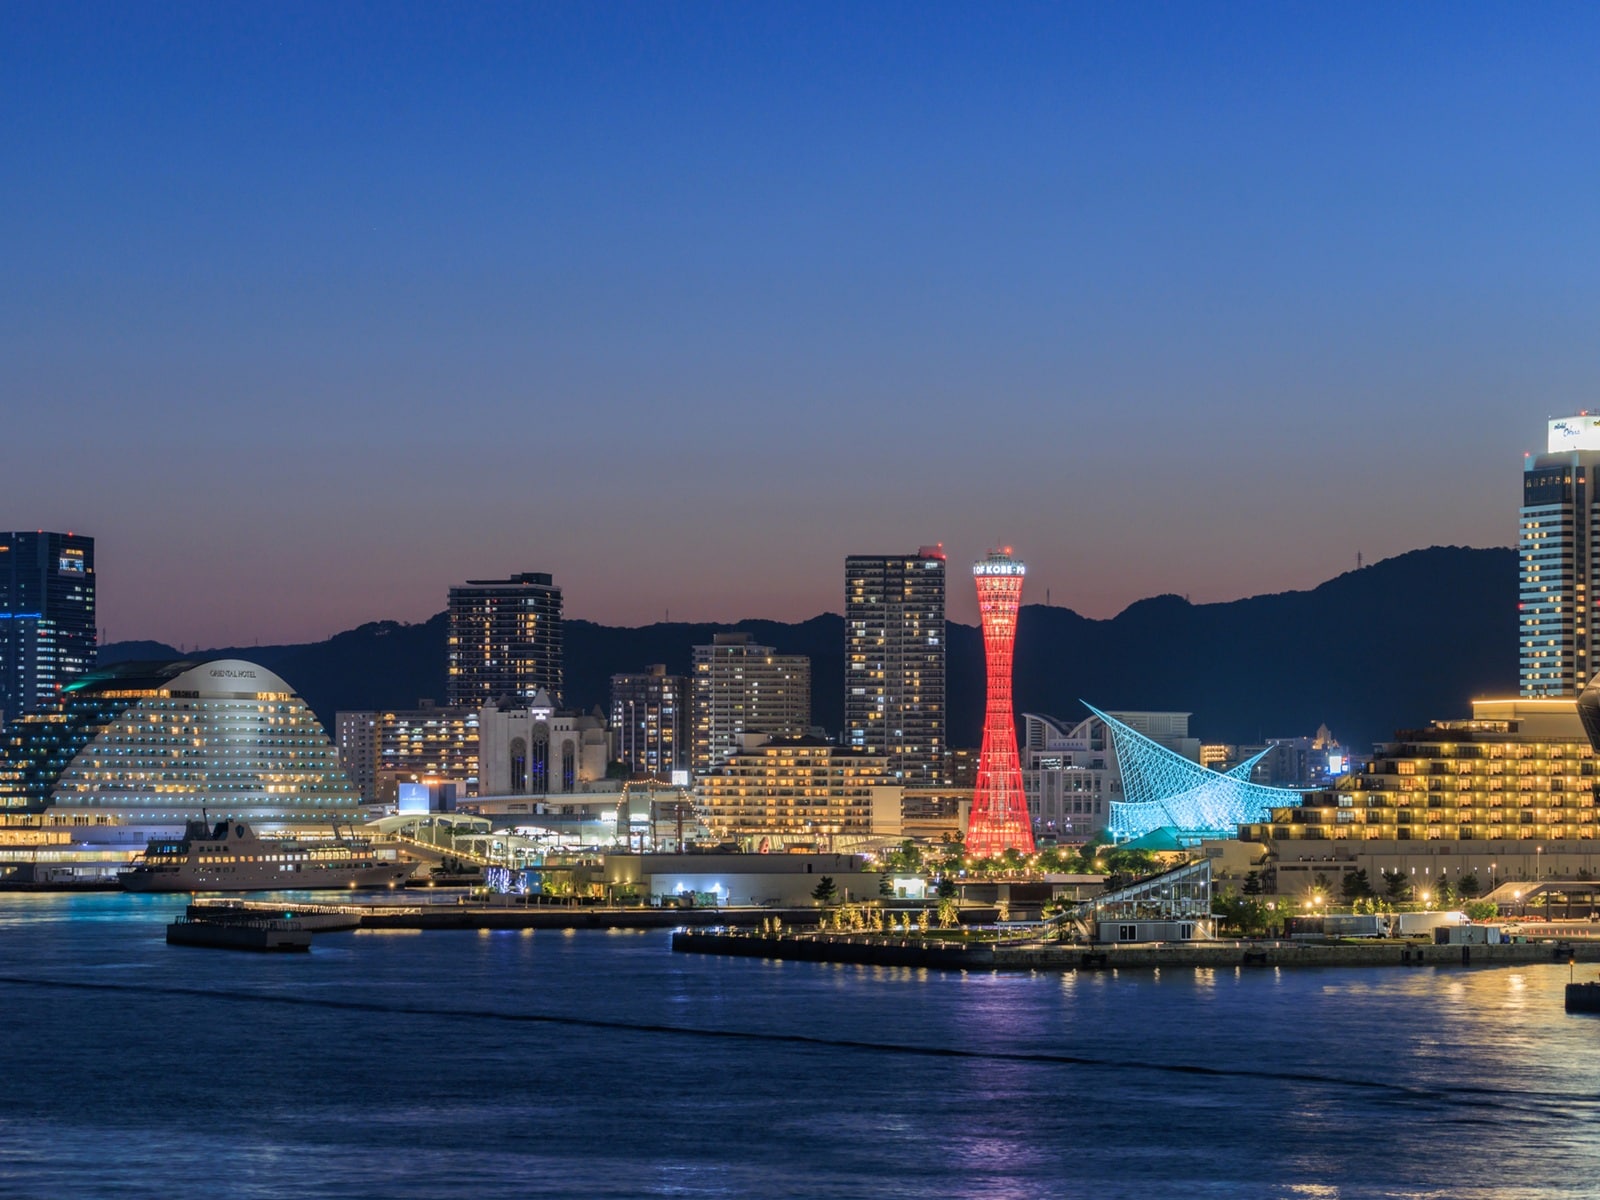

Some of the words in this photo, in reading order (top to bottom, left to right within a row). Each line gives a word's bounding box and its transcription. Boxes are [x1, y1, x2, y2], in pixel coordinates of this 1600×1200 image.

[986, 565, 1012, 575] KOBE
[210, 670, 238, 678] ORIENTAL
[238, 670, 257, 679] HOTEL
